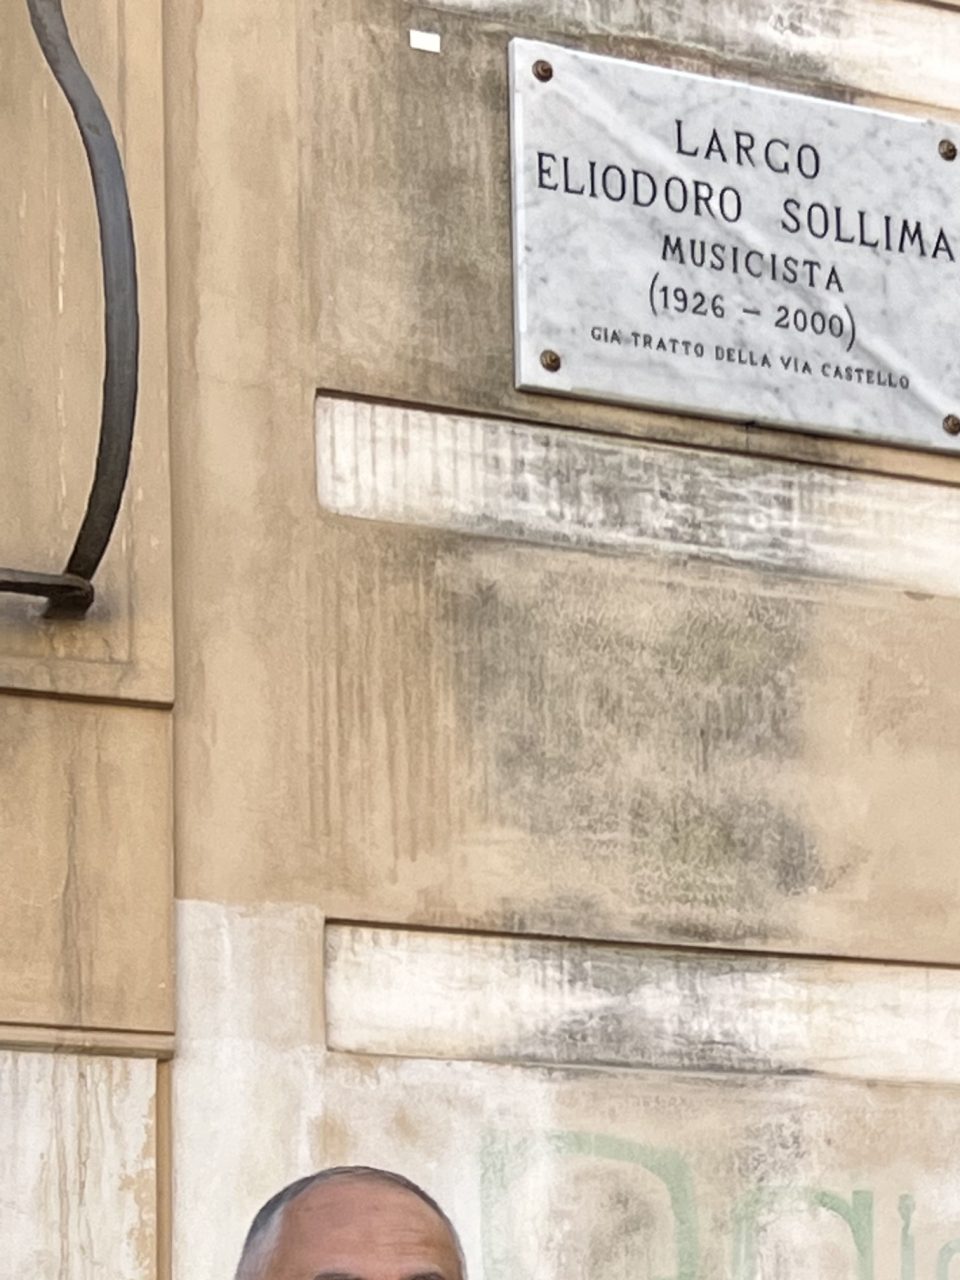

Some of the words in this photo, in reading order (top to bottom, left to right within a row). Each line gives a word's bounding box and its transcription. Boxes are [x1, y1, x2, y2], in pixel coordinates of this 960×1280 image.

[674, 119, 821, 180] LARGO
[536, 151, 743, 224] ELIODORO
[780, 198, 956, 263] SOLLIMA
[661, 234, 846, 294] MUSICISTA
[648, 271, 727, 319] (1926
[774, 304, 857, 353] 2000)
[630, 331, 705, 358] TRATTO
[714, 345, 772, 369] DELLA
[779, 355, 813, 376] VIA
[820, 362, 911, 390] CASTELLO
